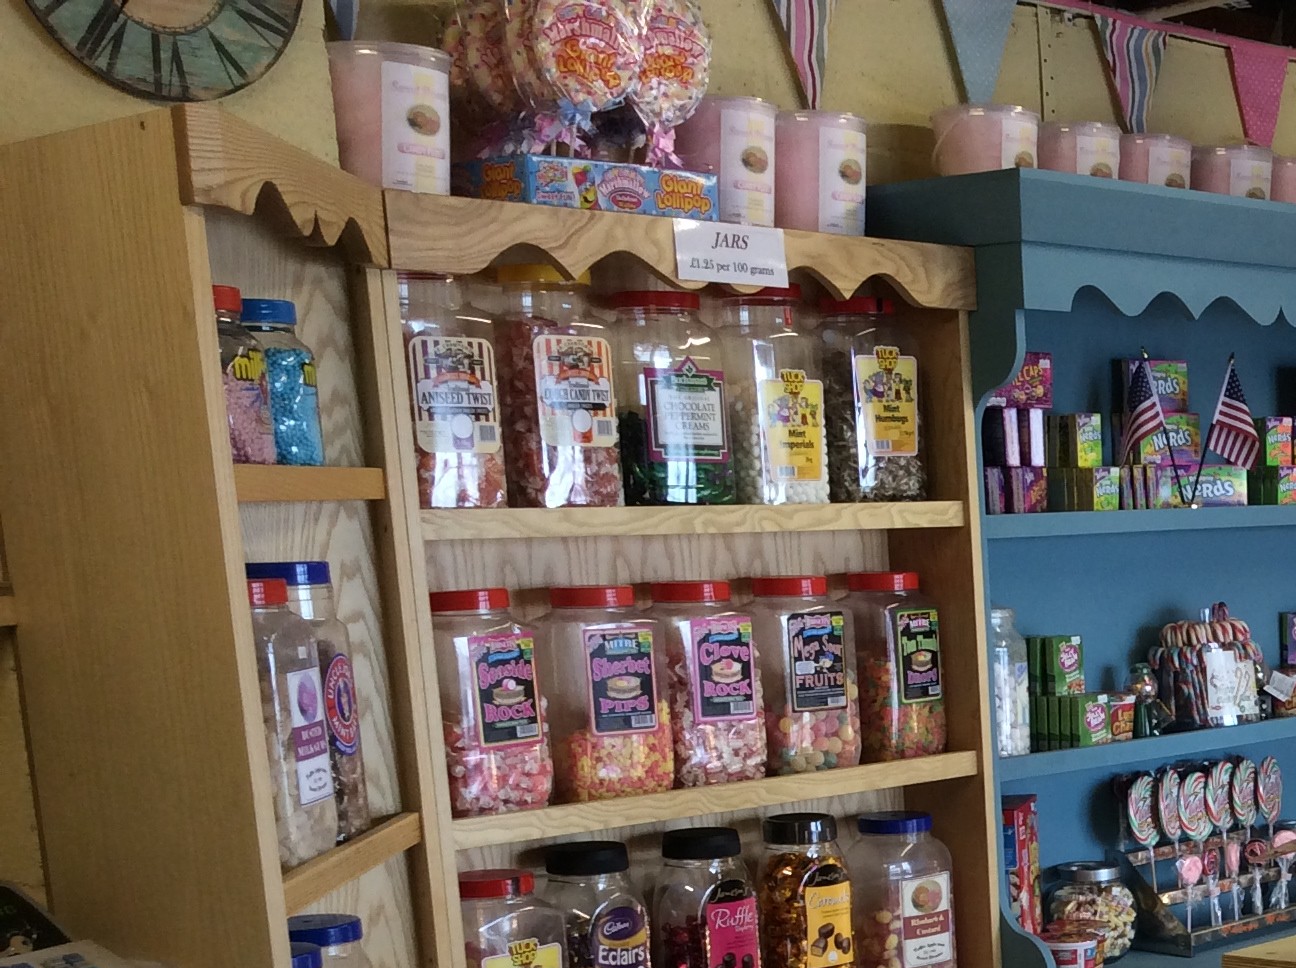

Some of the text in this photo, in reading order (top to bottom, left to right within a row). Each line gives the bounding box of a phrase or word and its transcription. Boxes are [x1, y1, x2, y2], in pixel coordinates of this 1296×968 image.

[660, 173, 704, 195] Giant
[656, 191, 712, 214] Lollipop
[712, 232, 749, 250] JARS
[690, 257, 775, 277] £1.25 per 100 grams
[876, 348, 899, 359] TUCK
[879, 358, 898, 369] SHOP
[782, 371, 805, 382] TUCK
[784, 382, 803, 393] SHOP
[421, 391, 492, 405] ANISEED TWIST
[570, 389, 591, 401] CANDY
[592, 389, 609, 401] TWIST
[664, 402, 716, 412] CHOCOLATE
[883, 404, 900, 413] Mint
[875, 413, 909, 425] Humbugs
[676, 422, 710, 431] CREAMS
[788, 429, 806, 439] Mint
[779, 440, 815, 450] Imperials
[605, 638, 640, 651] MITRE
[793, 634, 844, 660] Mega Sour
[700, 643, 750, 665] Clove
[592, 656, 650, 682] Sherbet
[795, 672, 845, 688] FRUITS
[702, 679, 752, 697] ROCK
[484, 700, 536, 723] ROCK
[599, 696, 649, 713] PIPS
[711, 905, 755, 930] Ruffle
[916, 925, 942, 936] Custard
[509, 943, 538, 957] TUCK
[599, 945, 645, 967] Eclairs
[511, 952, 537, 966] SHOP
